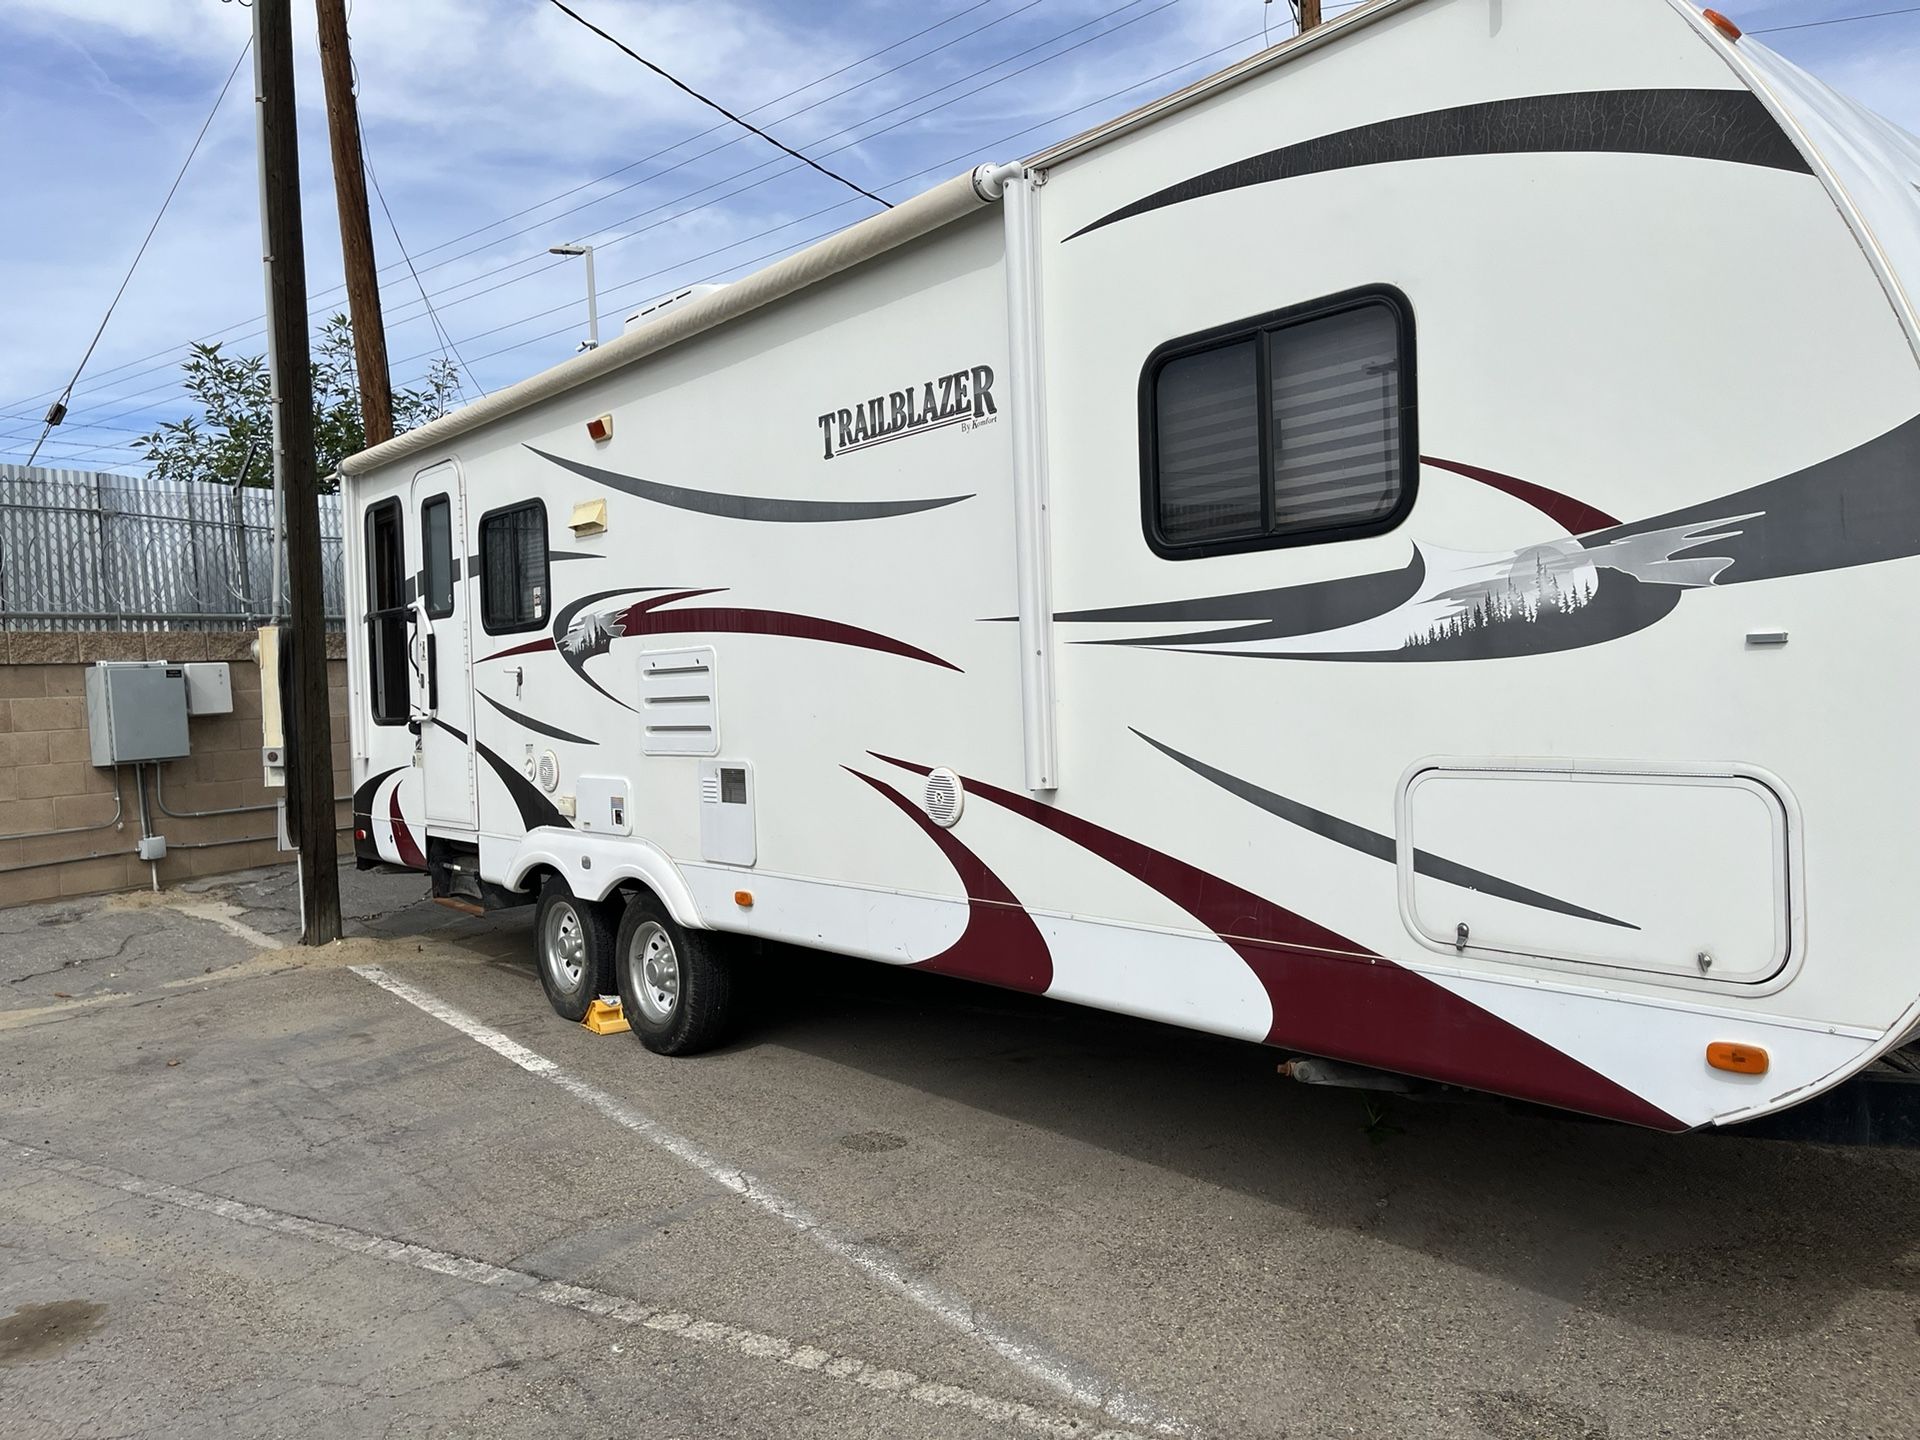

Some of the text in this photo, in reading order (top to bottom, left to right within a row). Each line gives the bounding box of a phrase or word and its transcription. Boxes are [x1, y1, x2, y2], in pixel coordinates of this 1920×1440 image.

[818, 365, 997, 460] TRAILBLAZER
[961, 416, 997, 434] By Komfort
